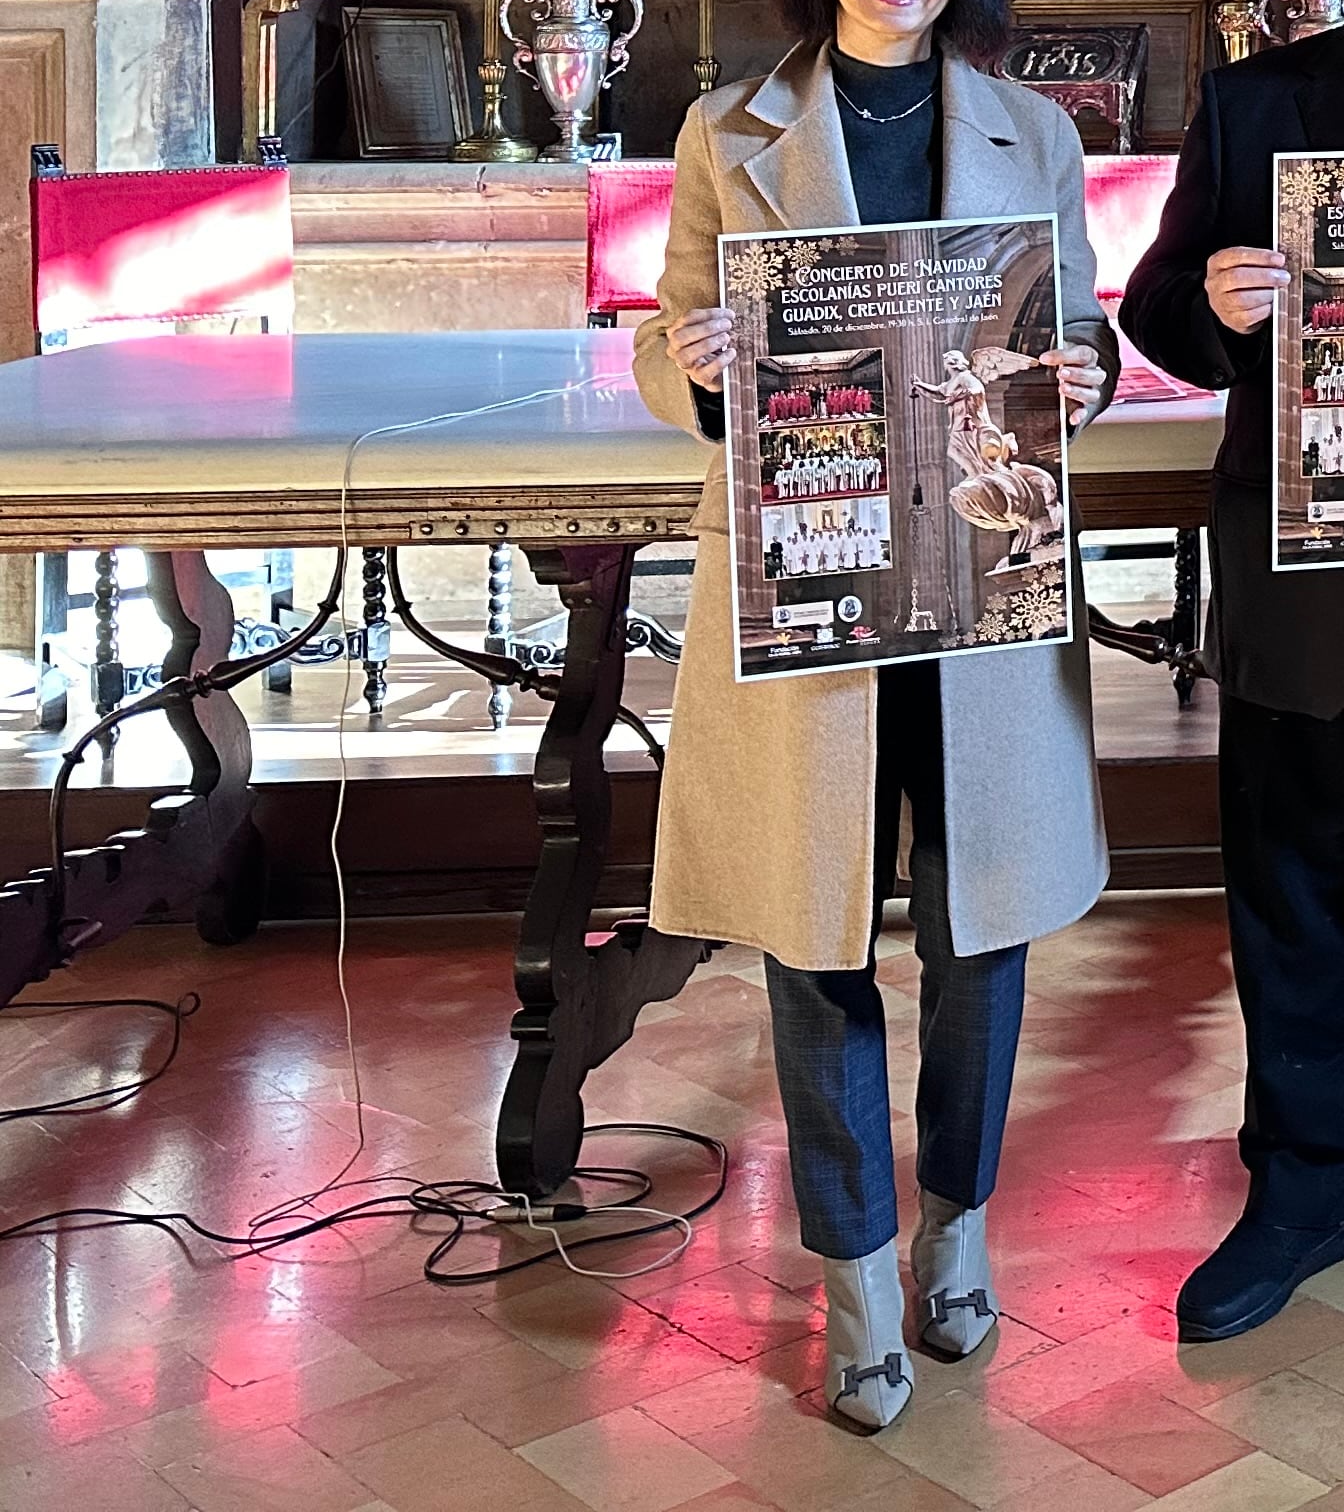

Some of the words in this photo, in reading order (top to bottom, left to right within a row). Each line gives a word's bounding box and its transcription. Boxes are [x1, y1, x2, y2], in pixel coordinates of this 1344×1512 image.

[795, 263, 884, 286] CONCIERTO
[889, 262, 909, 277] DE
[914, 257, 988, 279] NAVIDAD
[781, 283, 872, 304] ESCOLANÍAS
[877, 280, 921, 297] PUERI
[926, 274, 1003, 292] CANTORES
[782, 306, 843, 323] GUADIX,
[847, 297, 943, 318] CREVILLENTE
[950, 296, 960, 311] Y
[965, 291, 1002, 310] JAÉN
[821, 325, 832, 334] 20
[833, 324, 843, 333] de
